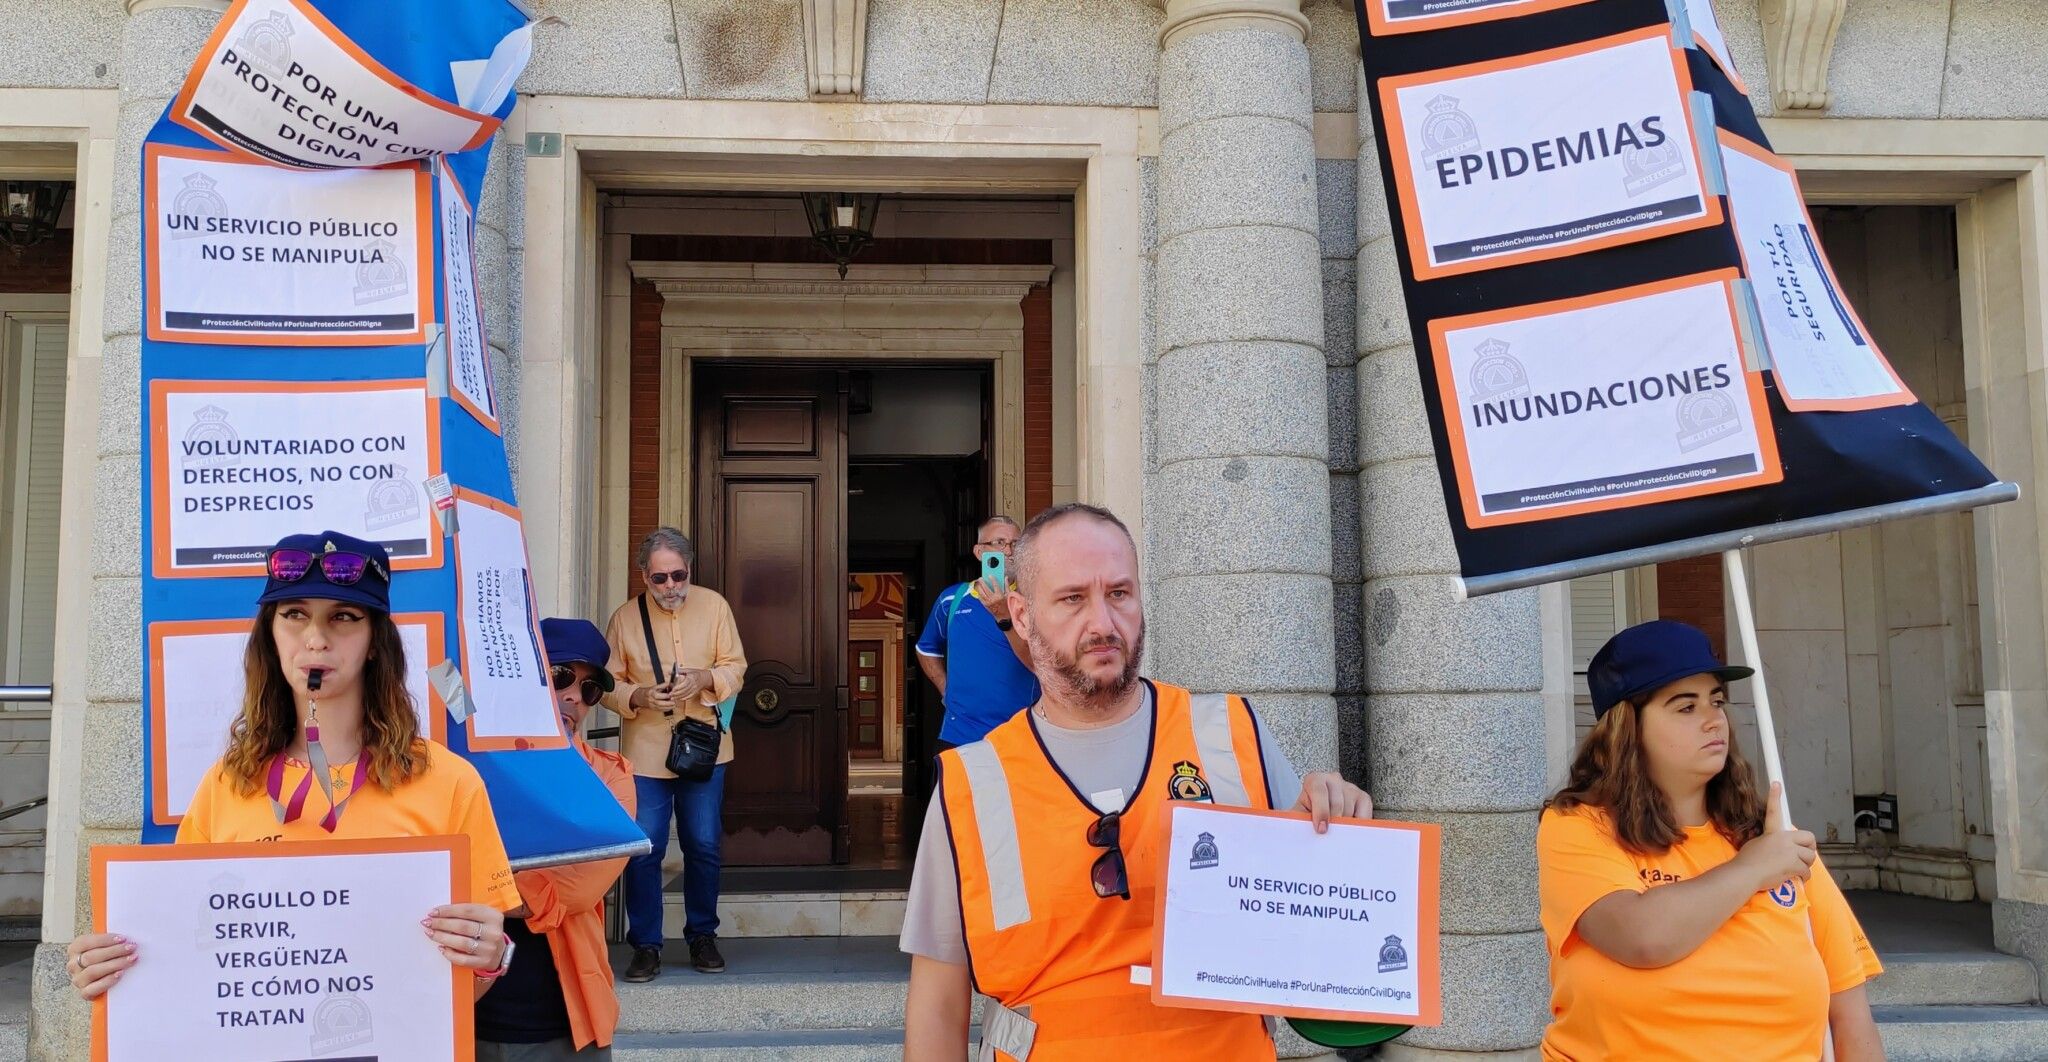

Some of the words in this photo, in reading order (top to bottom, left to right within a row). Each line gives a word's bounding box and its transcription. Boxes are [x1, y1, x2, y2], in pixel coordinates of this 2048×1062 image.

[220, 49, 378, 148] PROTECCIÓN
[287, 61, 337, 107] POR
[344, 99, 399, 135] UNA
[277, 123, 361, 162] DIGNA
[539, 135, 546, 154] 1
[1436, 115, 1666, 190] EPIDEMIAS
[167, 213, 199, 231] UN
[207, 217, 302, 237] SERVICIO
[310, 218, 398, 237] PÚBLICO
[1471, 232, 1554, 253] #ProtecciónCivilHuelva
[1555, 209, 1663, 239] #PorUnaProtecciónCivilDigna
[202, 244, 235, 261] NO
[242, 246, 264, 262] SE
[272, 247, 384, 264] MANIPULA
[1760, 240, 1781, 269] TÚ
[1774, 223, 1826, 341] SEGURIDAD
[1776, 276, 1799, 318] POR
[201, 319, 283, 328] #ProtecciónCivilHuelva
[283, 320, 382, 329] #PorUnaProtecciónCivilDigna
[1473, 363, 1731, 428] INUNDACIONES
[182, 438, 355, 456] VOLUNTARIADO
[361, 435, 406, 453] CON
[183, 467, 303, 485] DERECHOS,
[310, 466, 342, 482] NO
[349, 464, 394, 481] CON
[1520, 484, 1606, 504] #ProtecciónCivilHuelva
[1606, 466, 1717, 493] #PorUnaProtecciónCivilDigna
[184, 495, 314, 513] DESPRECIOS
[477, 571, 491, 651] LUCHAMOS
[486, 566, 498, 645] NOSOTROS.
[495, 601, 514, 679] LUCHAMOS
[486, 655, 495, 677] NO
[494, 650, 505, 678] POR
[508, 633, 522, 680] TODOS
[209, 891, 315, 910] ORGULLO
[323, 889, 350, 906] DE
[1228, 875, 1249, 889] UN
[1253, 878, 1324, 897] SERVICIO
[1328, 883, 1396, 903] PÚBLICO
[1239, 898, 1262, 912] NO
[1266, 900, 1286, 915] SE
[1290, 903, 1369, 922] MANIPULA
[215, 921, 296, 939] SERVIR,
[215, 946, 348, 969] VERGÜENZA
[217, 981, 244, 998] DE
[251, 975, 320, 997] CÓMO
[328, 975, 374, 993] NOS
[1196, 971, 1288, 990] #ProtecciónCivilHuelva
[1290, 980, 1411, 1000] #PorUnaProtecciónCivilDigna
[217, 1008, 304, 1027] TRATAN
